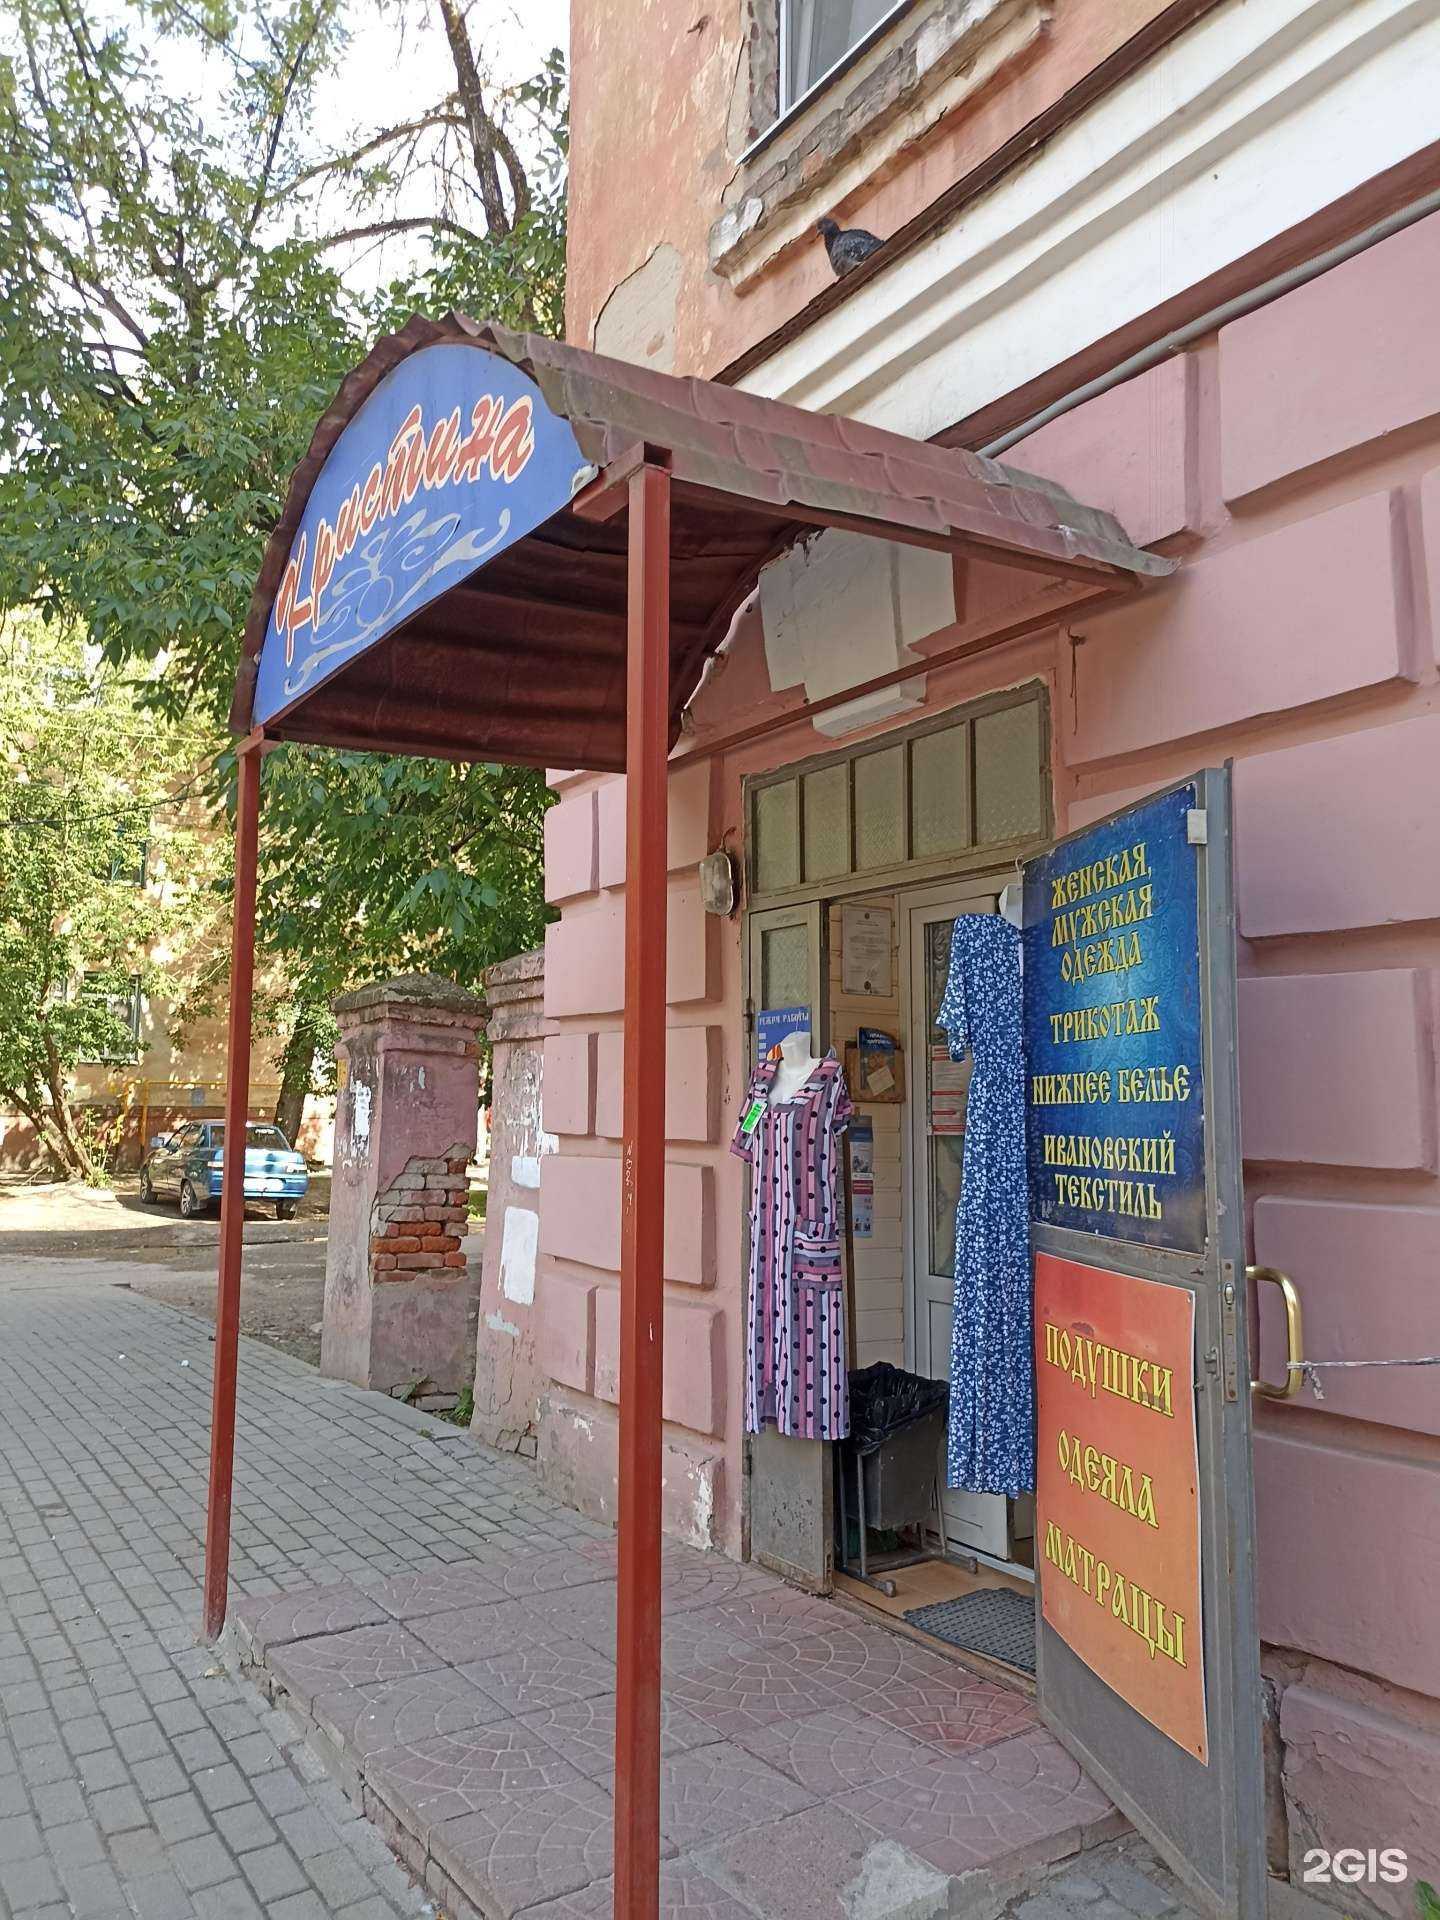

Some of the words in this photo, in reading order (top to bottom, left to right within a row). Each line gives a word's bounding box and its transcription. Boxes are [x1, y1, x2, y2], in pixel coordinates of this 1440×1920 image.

[275, 394, 535, 667] Кристина
[1051, 884, 1153, 948] МУЖСКАЯ
[1061, 932, 1141, 984] ОДЕЖДА
[1049, 995, 1161, 1044] ТРИКОТАЖ
[1032, 1069, 1111, 1105] НИЖНЕЕ
[1117, 1064, 1191, 1103] БЕЛЬЕ
[1043, 1130, 1176, 1175] ИВАНОВСКИЙ
[1055, 1173, 1162, 1220] ТЕКСТИЛЬ
[1044, 1322, 1175, 1418] ПОДУШКИ
[1057, 1428, 1159, 1529] ОДЕЯЛА
[1044, 1521, 1188, 1667] МАТРАЦЫ
